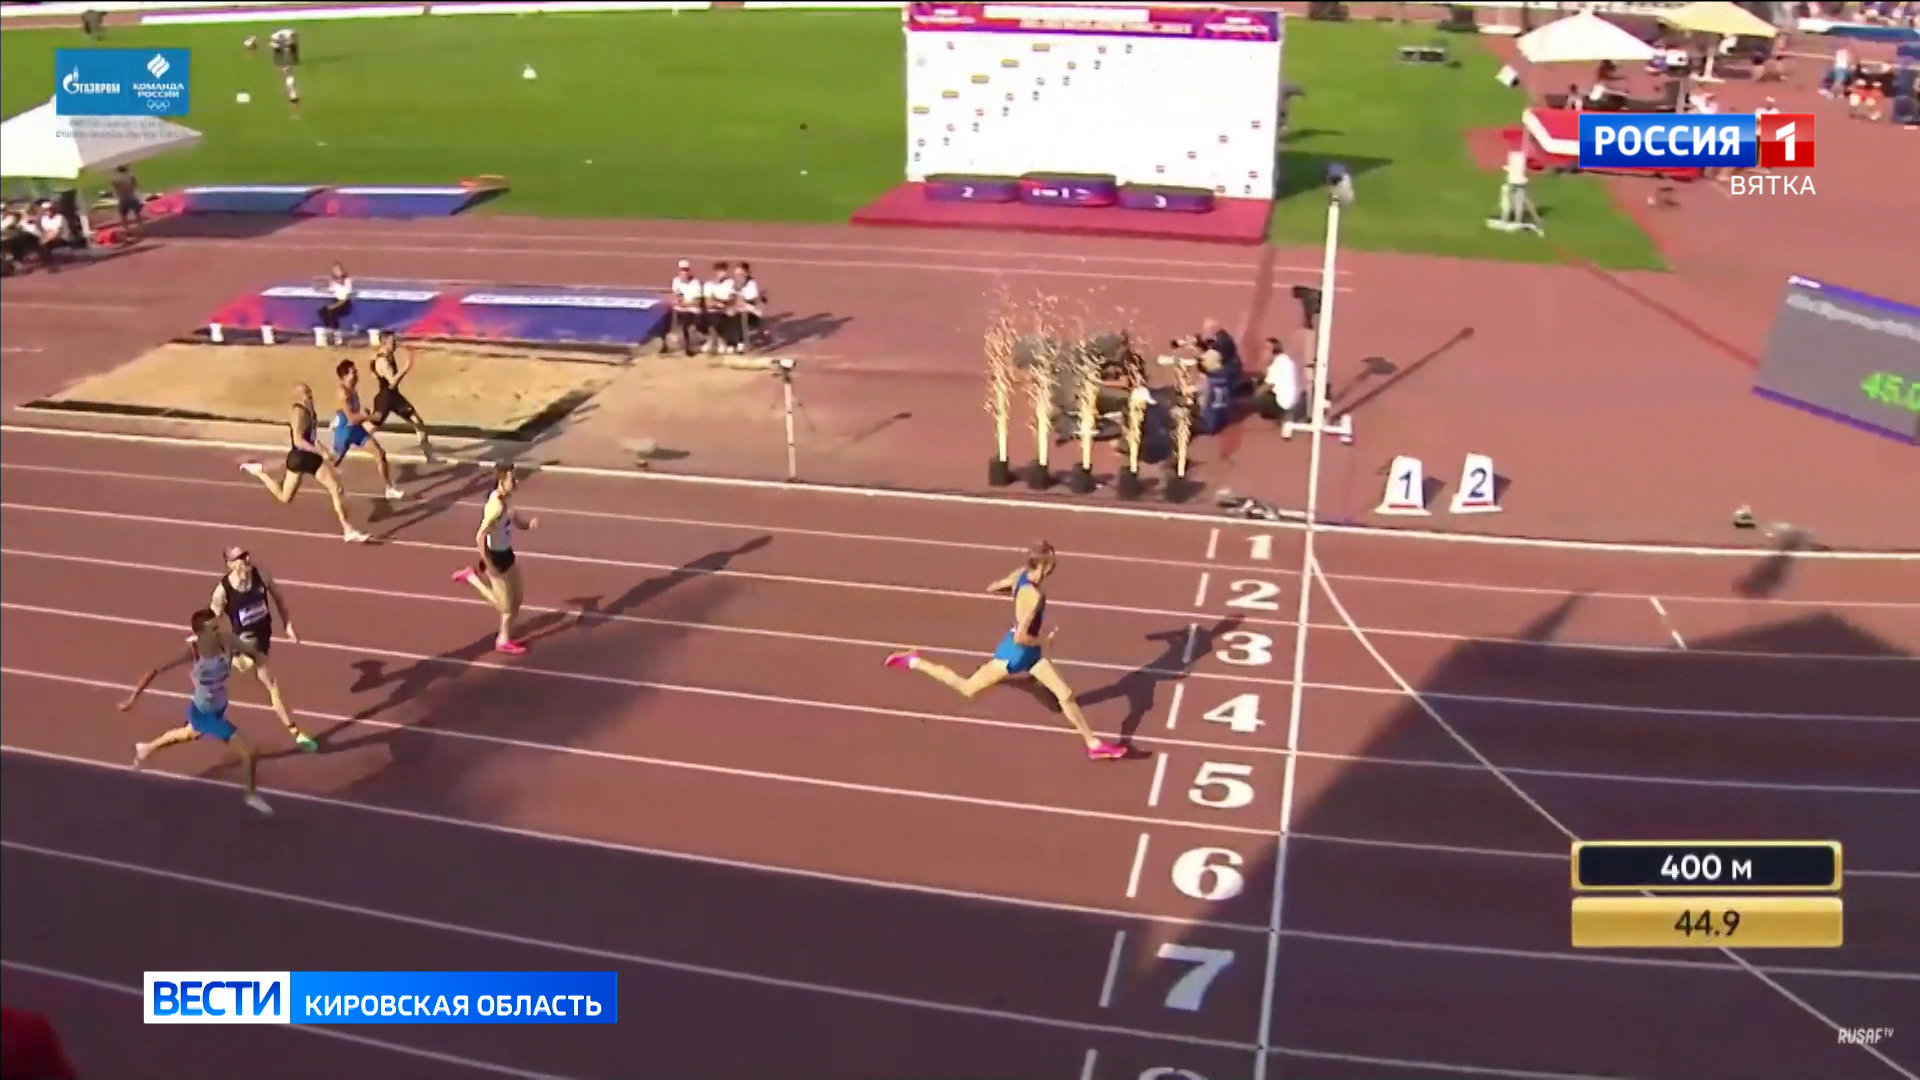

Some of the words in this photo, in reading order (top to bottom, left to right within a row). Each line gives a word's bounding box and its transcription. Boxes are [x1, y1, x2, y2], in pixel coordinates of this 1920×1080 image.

[1398, 469, 1413, 500] 1
[1468, 466, 1488, 498] 2
[1245, 534, 1274, 560] 1
[1225, 579, 1281, 611] 2
[1215, 631, 1273, 667] 3
[1203, 693, 1265, 733] 4
[1188, 760, 1256, 809] 5
[1171, 846, 1245, 902] 6
[1156, 942, 1235, 1012] 7
